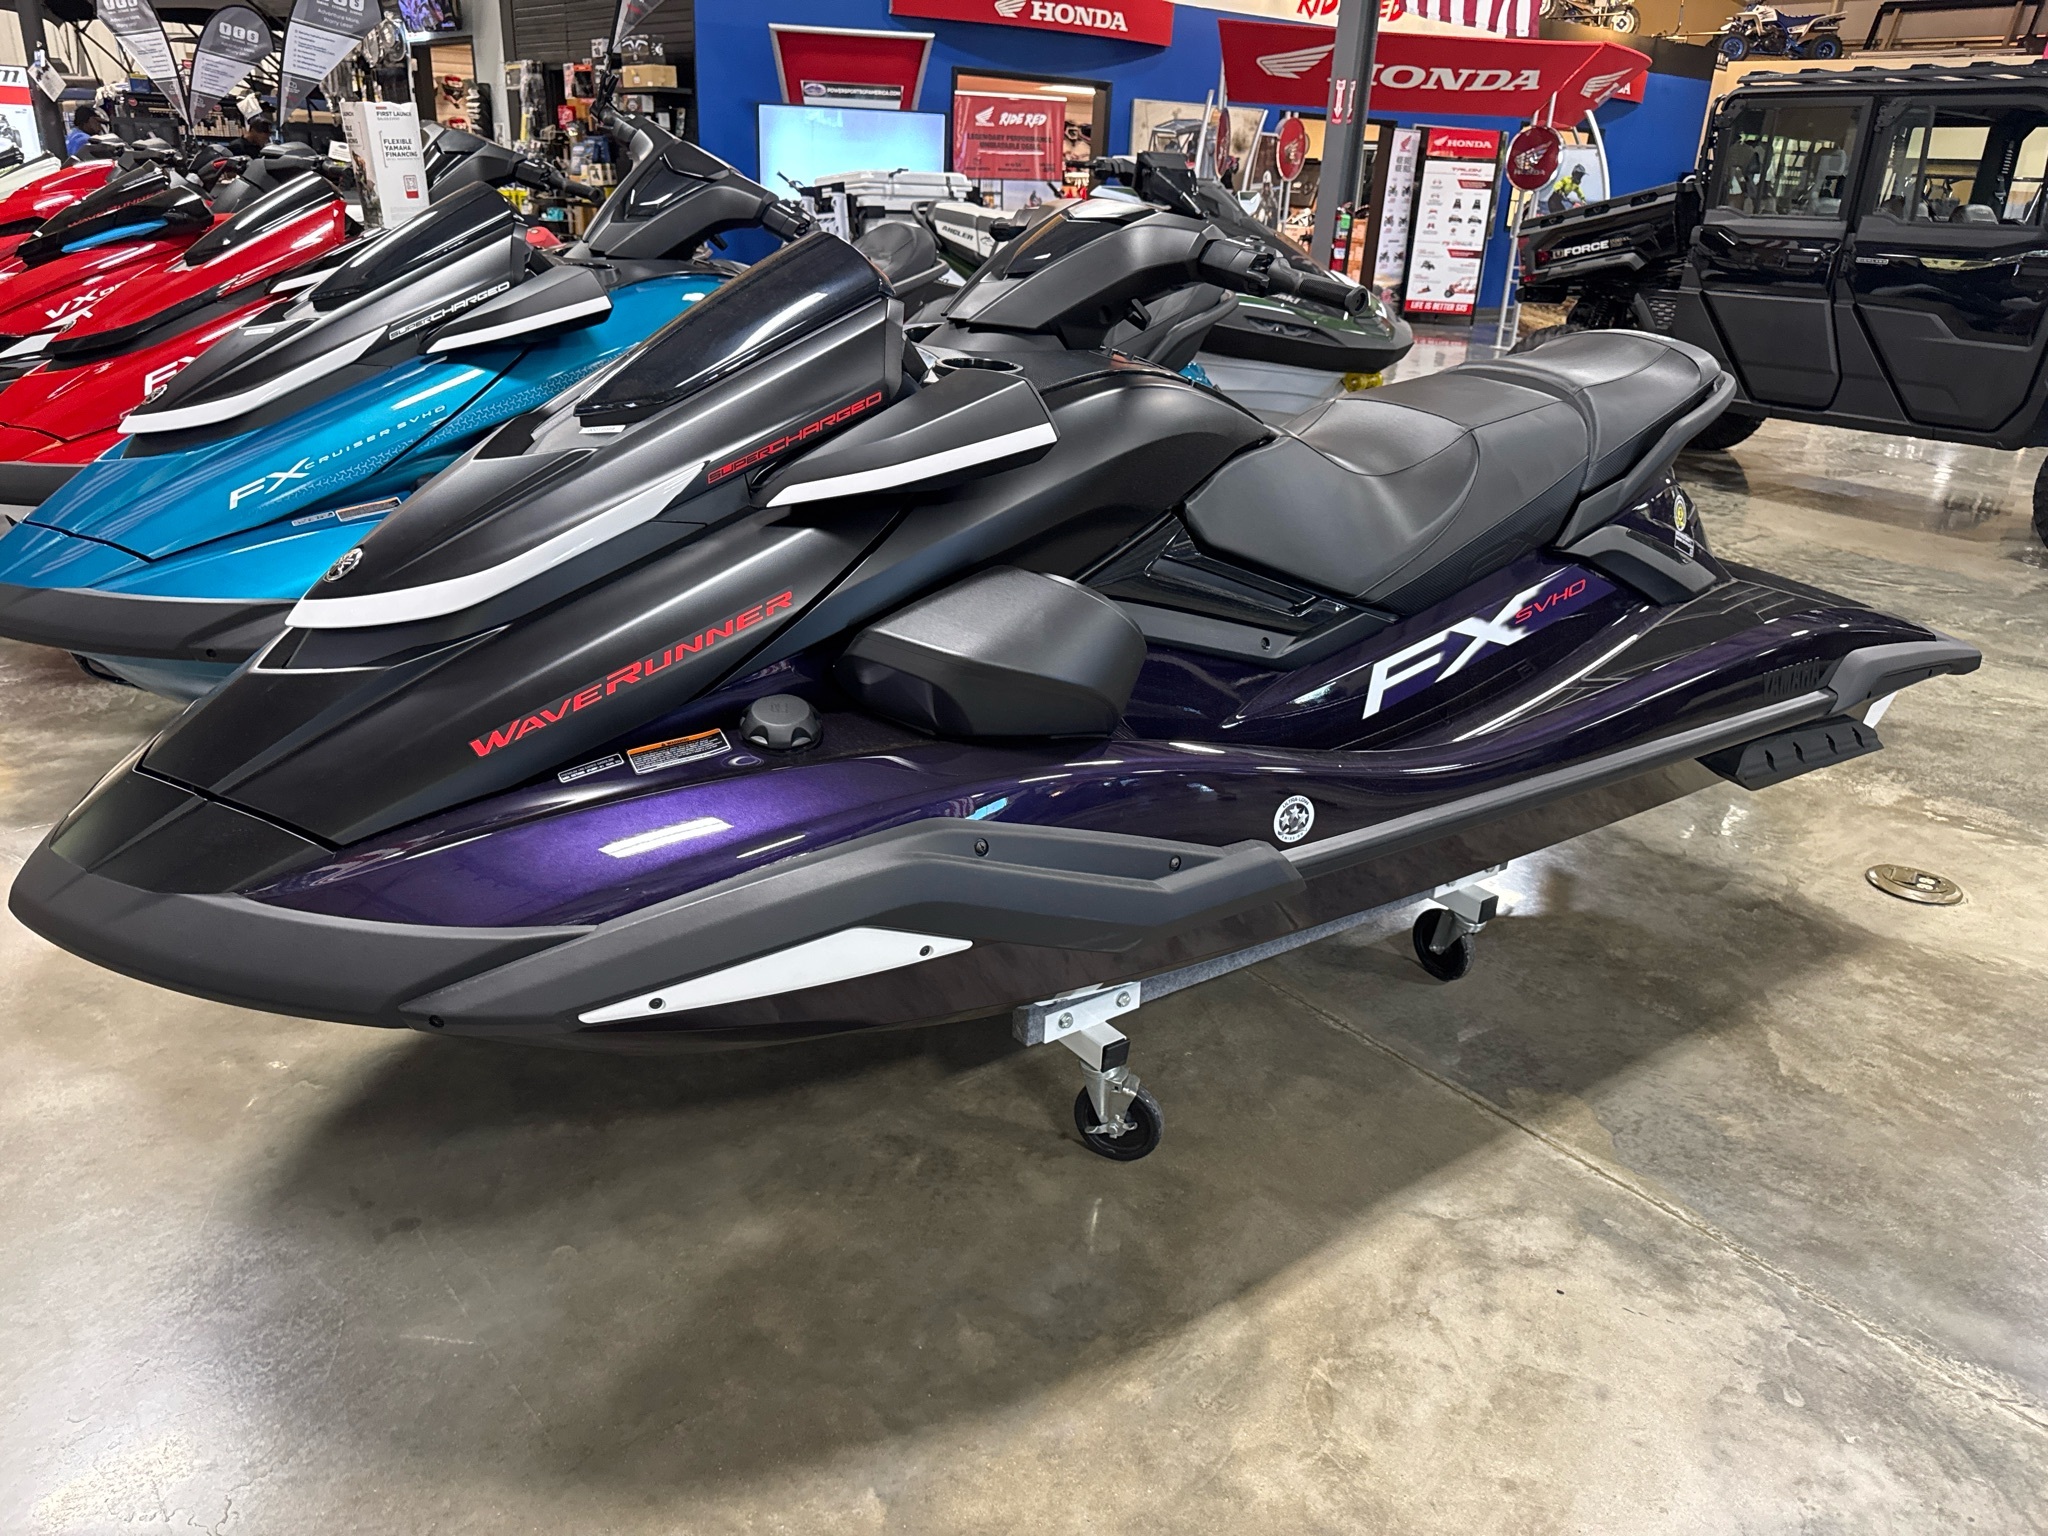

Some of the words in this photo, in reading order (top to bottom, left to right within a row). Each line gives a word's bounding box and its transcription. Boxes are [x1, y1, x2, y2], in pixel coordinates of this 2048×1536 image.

[221, 23, 257, 42] YES
[1030, 1, 1128, 32] HONDA
[999, 112, 1025, 127] RIDE
[1024, 113, 1048, 129] RED
[1446, 139, 1493, 149] HONDA
[941, 225, 974, 241] ANGLER
[389, 281, 511, 341] SUPERCHARGED
[1410, 301, 1424, 309] LIFE
[1432, 302, 1455, 311] BETTER
[707, 390, 883, 485] SUPERCHARGED
[229, 456, 310, 510] FX
[305, 428, 391, 471] CRUISER
[397, 405, 446, 430] SVHO
[1362, 576, 1556, 720] FX
[1515, 578, 1587, 625] SVHO
[470, 591, 794, 758] WAVERUNNER
[1763, 656, 1820, 698] YAMAHA
